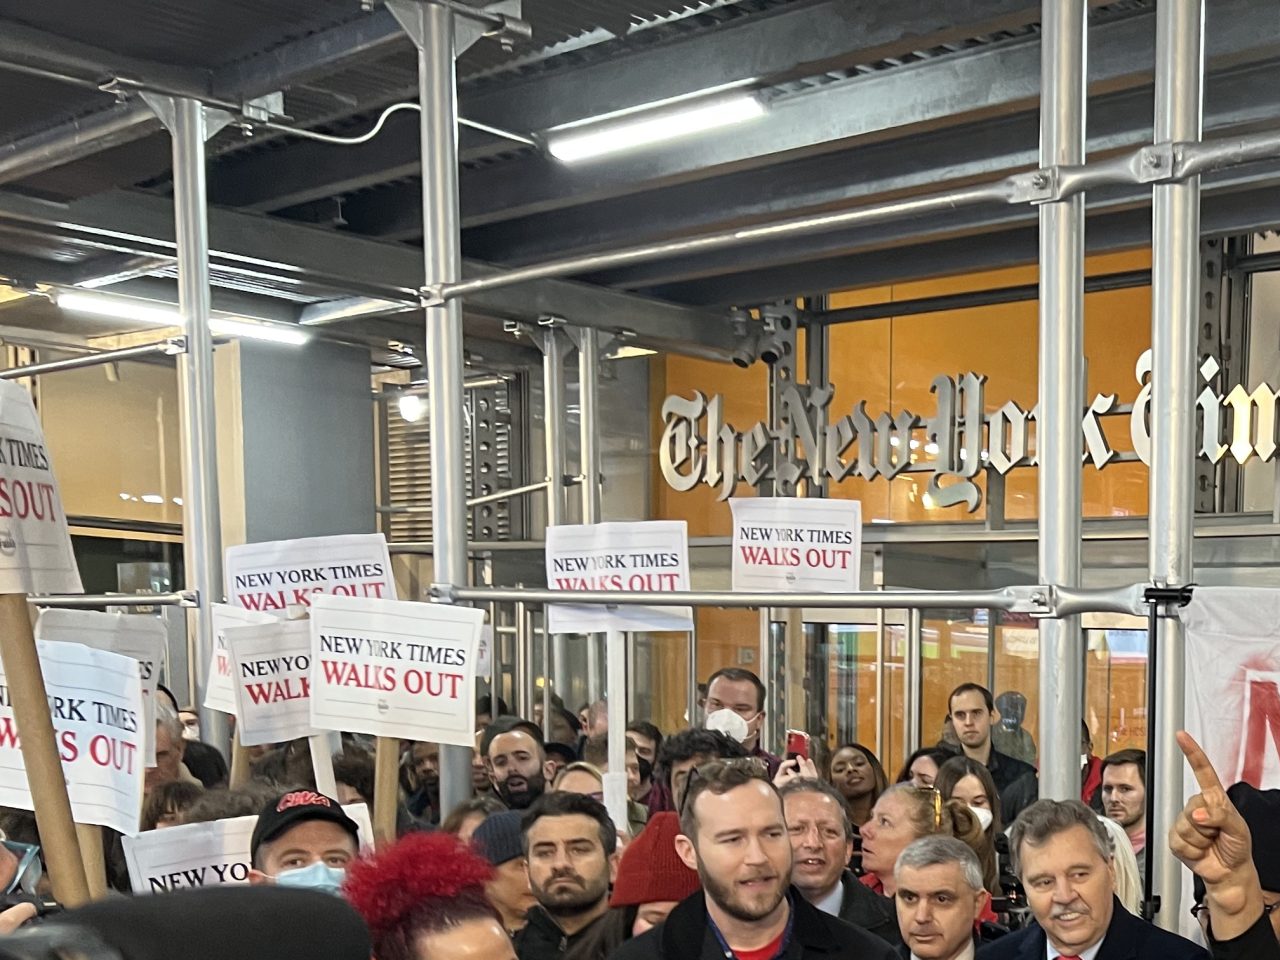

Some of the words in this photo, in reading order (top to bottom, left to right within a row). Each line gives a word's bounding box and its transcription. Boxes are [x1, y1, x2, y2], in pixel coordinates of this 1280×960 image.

[6, 438, 49, 471] TIMES
[660, 389, 772, 501] The
[772, 383, 921, 496] New
[12, 480, 56, 522] OUT
[740, 527, 773, 541] NEW
[807, 529, 852, 545] TIMES
[553, 557, 589, 573] NEW
[630, 553, 679, 568] TIMES
[740, 546, 801, 567] WALKS
[806, 548, 852, 569] OUT
[235, 572, 273, 589] NEW
[277, 567, 327, 585] YORK
[328, 563, 383, 580] TIMES
[238, 587, 324, 611] WALK
[241, 658, 281, 677] NEW
[281, 655, 311, 671] YO
[320, 635, 364, 655] NEW
[407, 643, 466, 666] TIMES
[245, 677, 310, 705] WALK
[321, 660, 396, 691] WALKS
[404, 669, 464, 699] OUT
[92, 701, 137, 733] TIMES
[90, 734, 137, 774] OUT
[148, 867, 206, 894] NEW
[210, 862, 250, 883] YO
